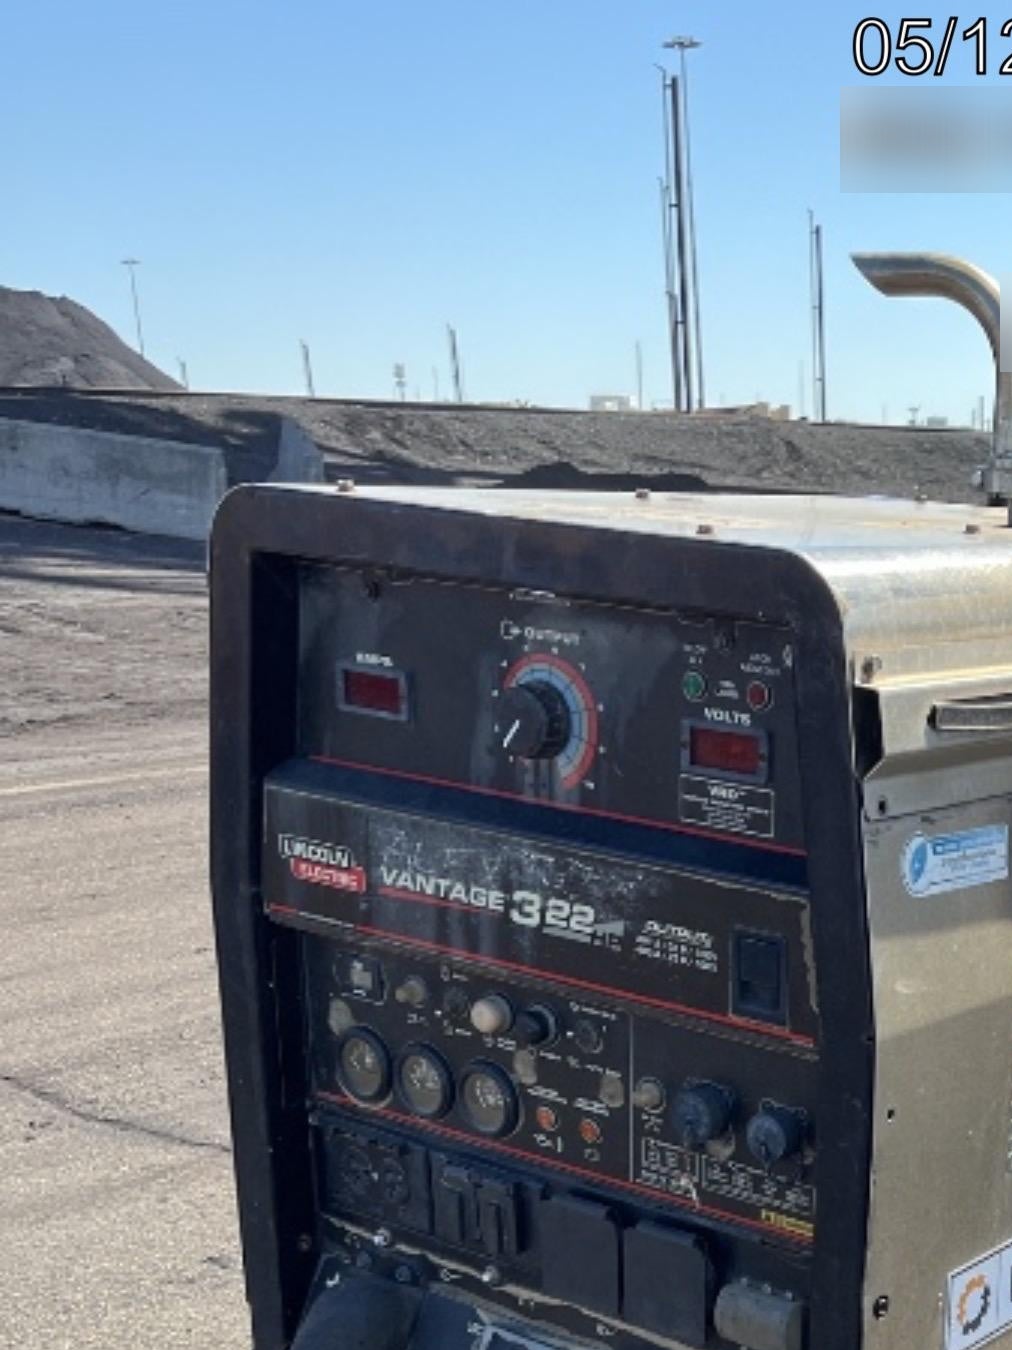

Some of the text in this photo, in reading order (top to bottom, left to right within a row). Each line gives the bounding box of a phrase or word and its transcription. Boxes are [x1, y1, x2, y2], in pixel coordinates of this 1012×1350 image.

[703, 707, 751, 726] VOLTS
[282, 838, 350, 868] LINCOLN
[378, 866, 595, 935] VANTAGE 322
